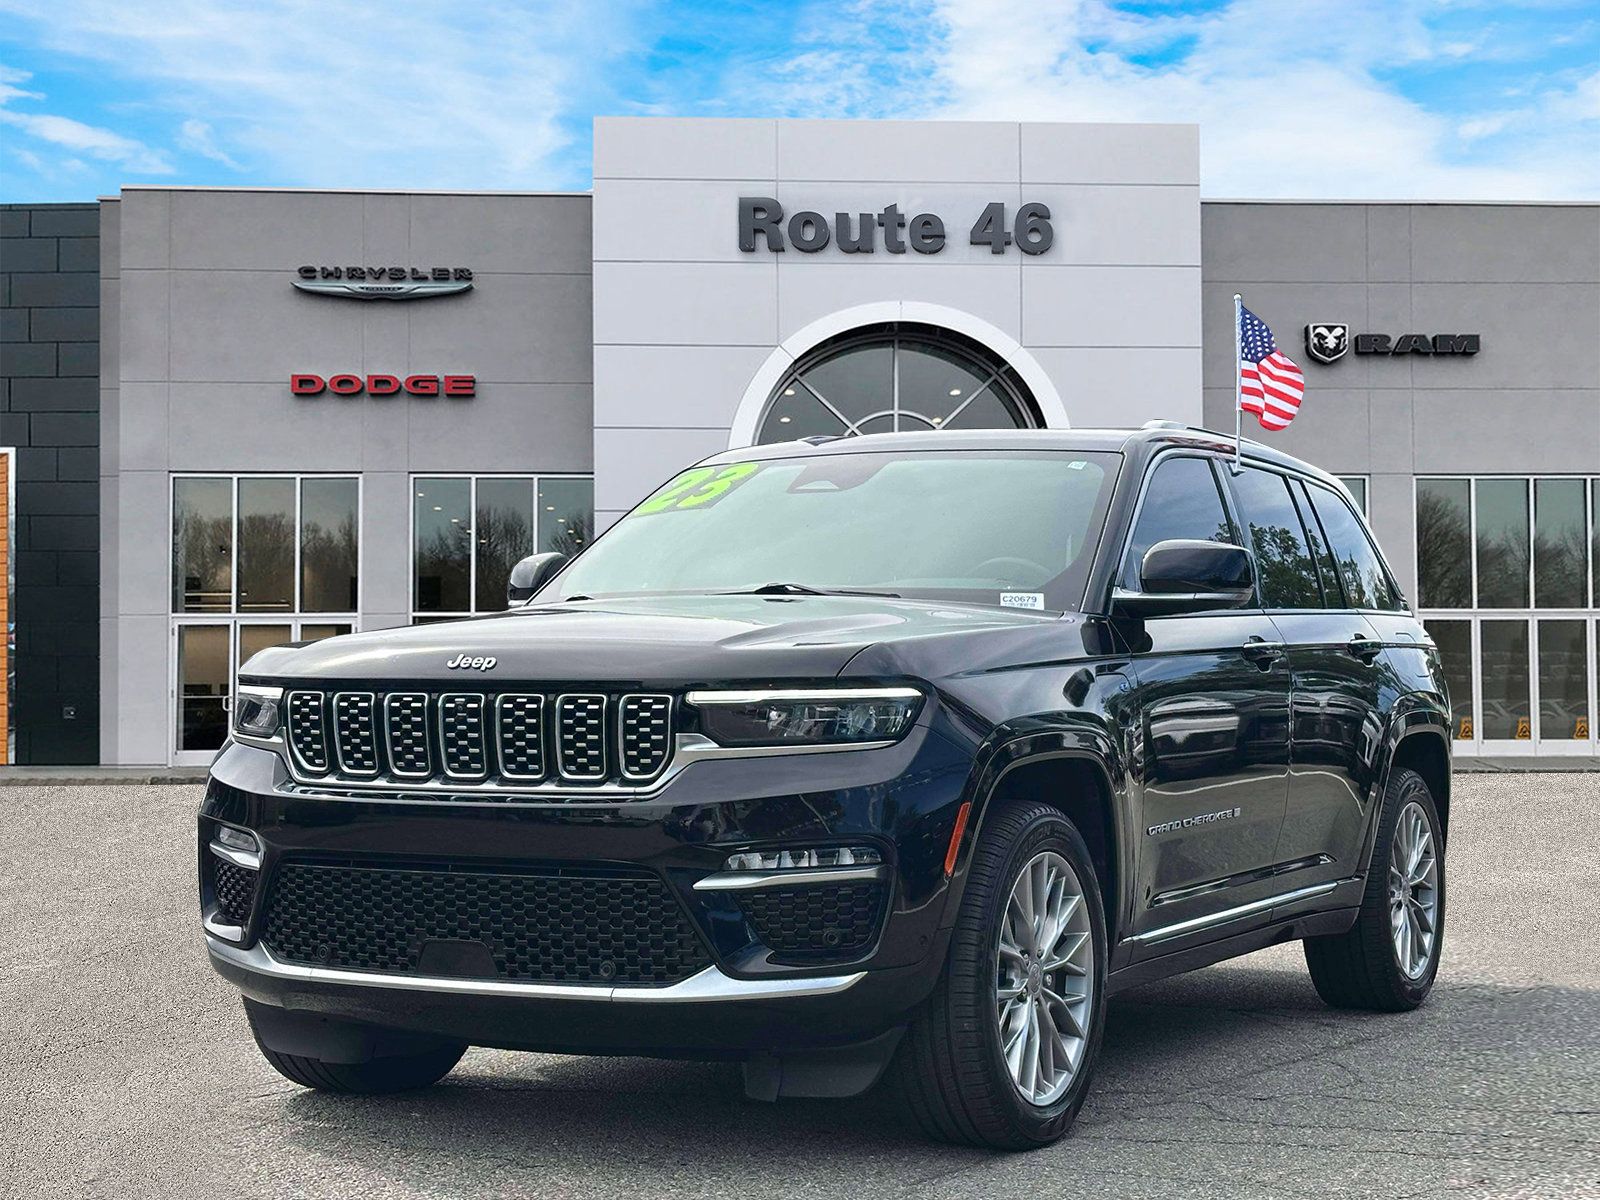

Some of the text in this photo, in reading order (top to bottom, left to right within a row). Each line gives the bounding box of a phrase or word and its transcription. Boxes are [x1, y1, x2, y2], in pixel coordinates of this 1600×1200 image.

[738, 196, 1054, 256] Route 46
[298, 266, 473, 281] CHRYSLER
[1354, 334, 1480, 355] RAM
[291, 374, 476, 398] DODGE
[633, 463, 759, 516] 23
[1002, 595, 1037, 603] C20679
[446, 653, 498, 672] Jeep
[1147, 820, 1181, 836] GRAND
[1182, 809, 1234, 828] CHEROKEE
